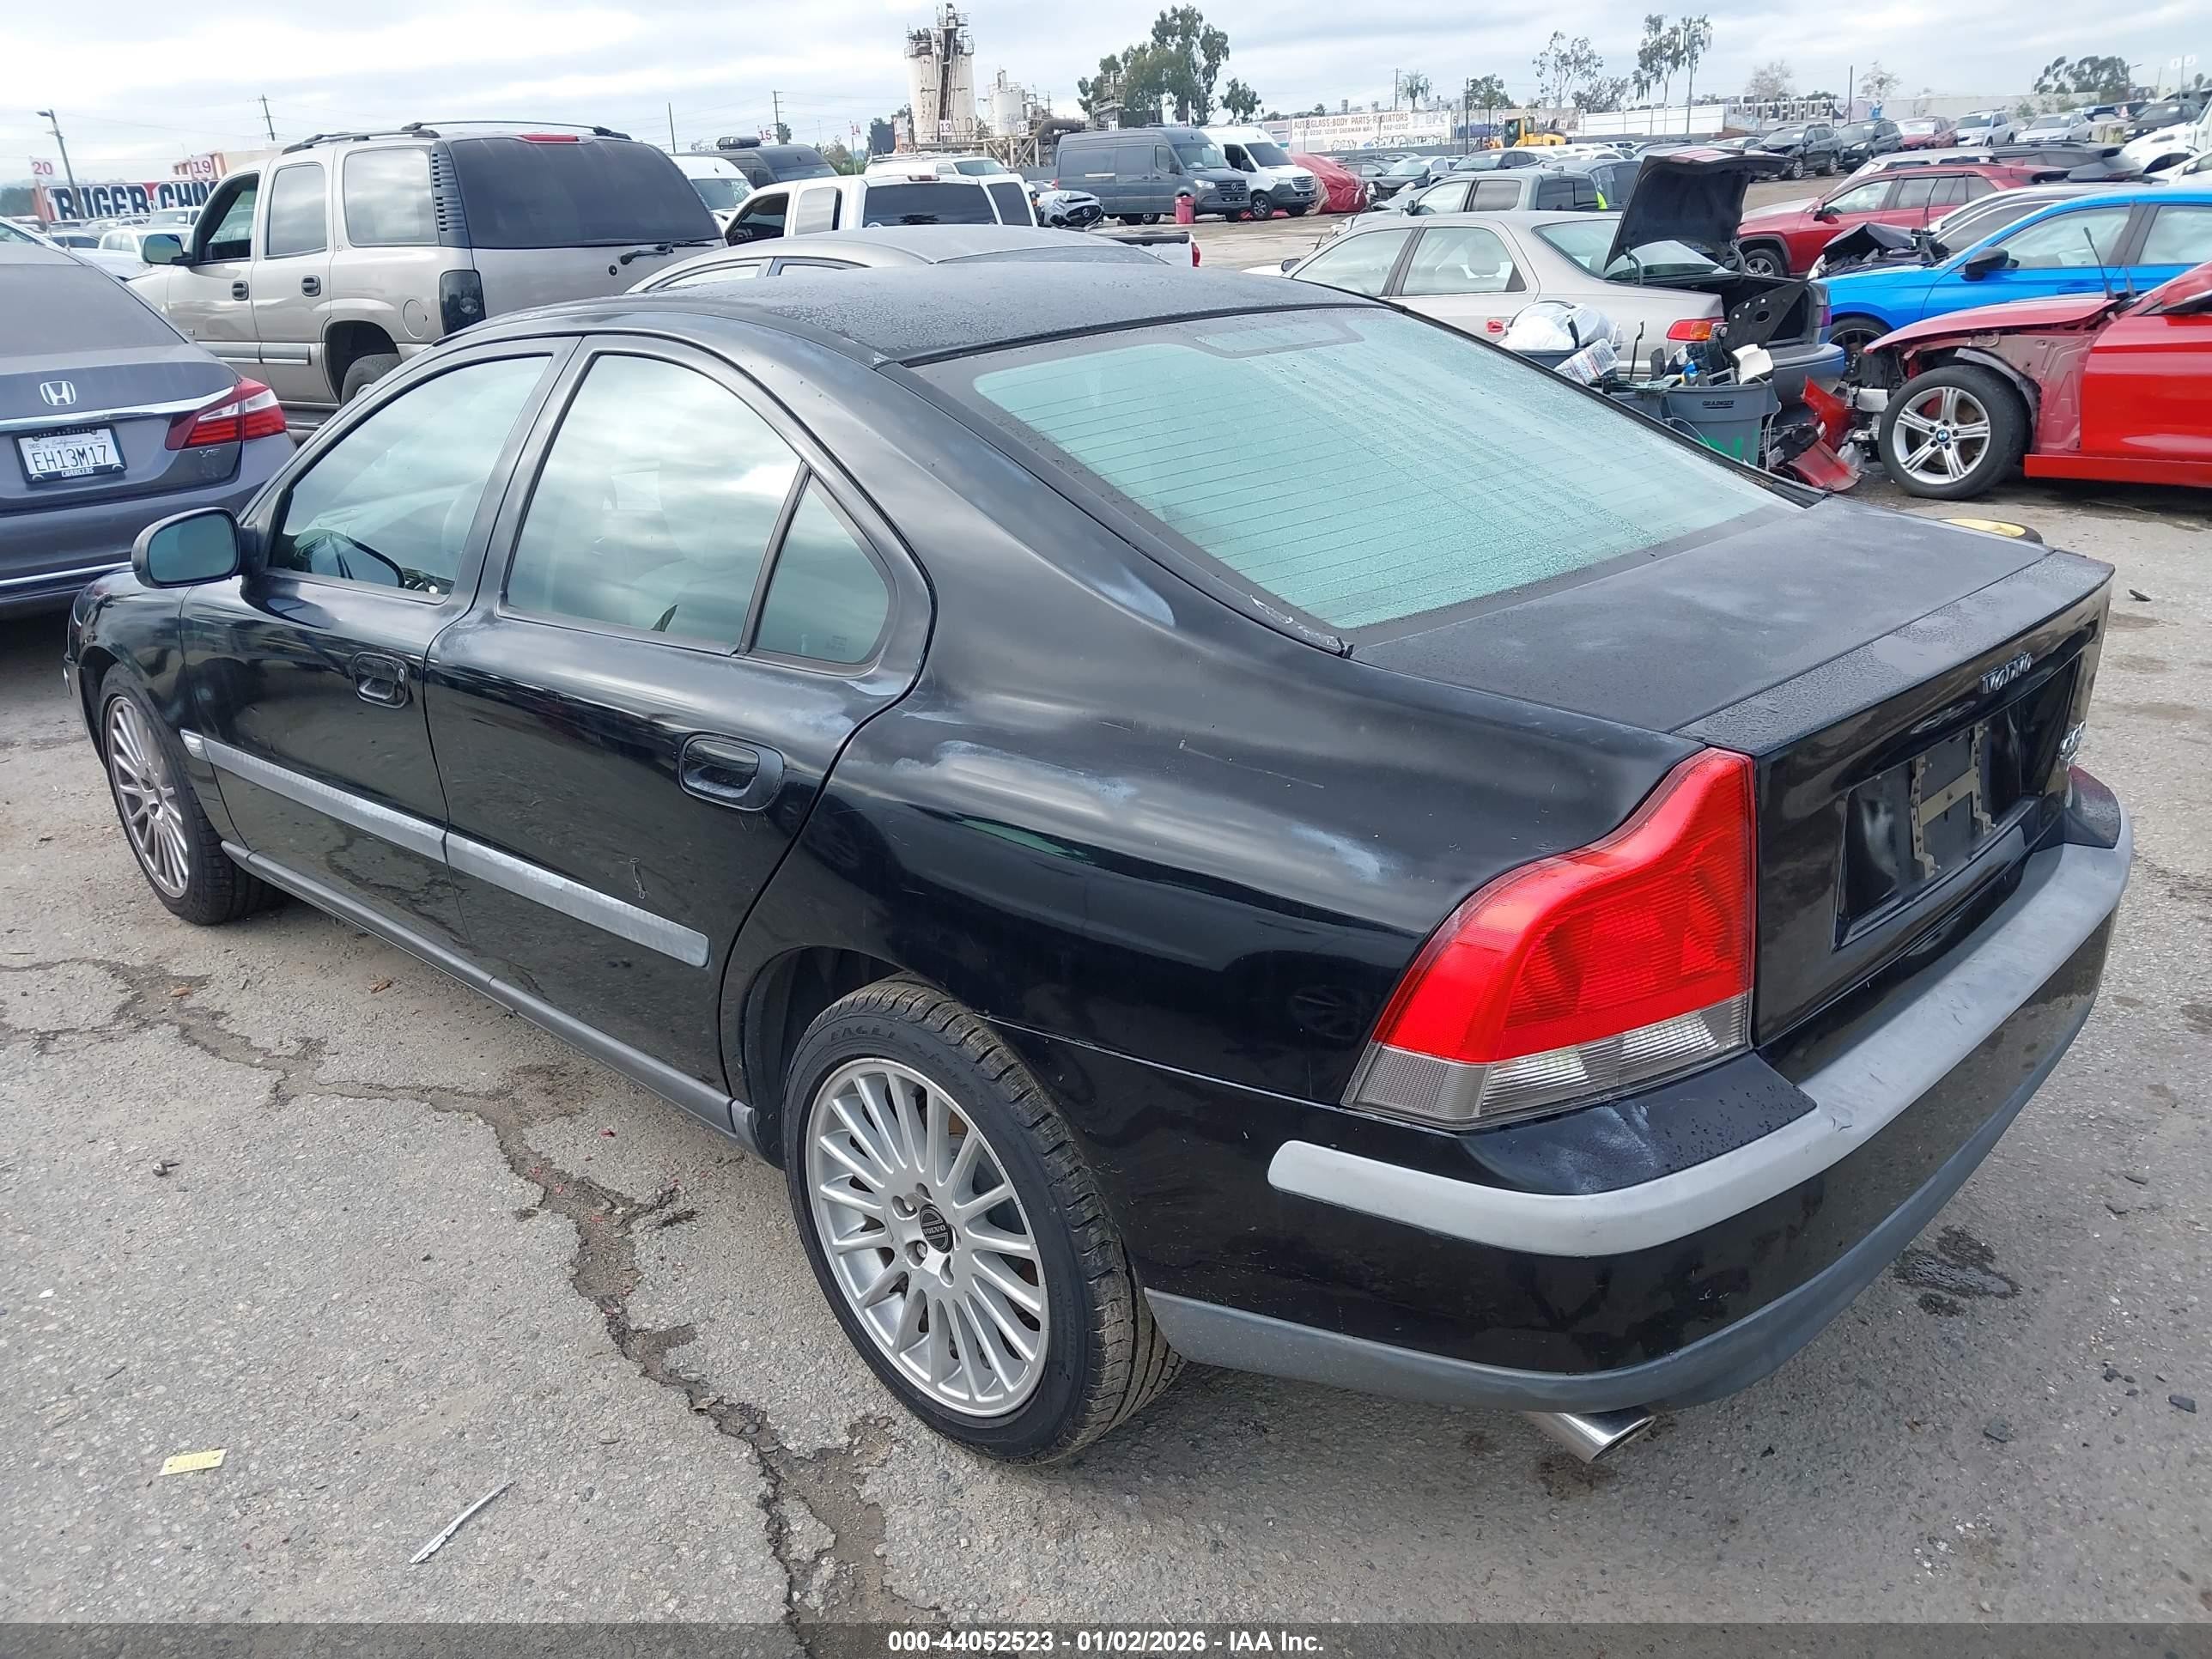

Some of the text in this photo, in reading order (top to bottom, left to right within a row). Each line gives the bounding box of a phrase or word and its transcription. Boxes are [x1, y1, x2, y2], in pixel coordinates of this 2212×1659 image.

[1452, 115, 1458, 125] 6
[1498, 114, 1504, 123] 5
[850, 125, 860, 136] 14
[939, 123, 951, 133] 13
[1017, 124, 1028, 134] 12
[758, 129, 772, 141] 15
[32, 161, 54, 176] 20
[192, 160, 212, 174] 19
[32, 444, 107, 472] EH13M17
[923, 1225, 945, 1235] VOLVO
